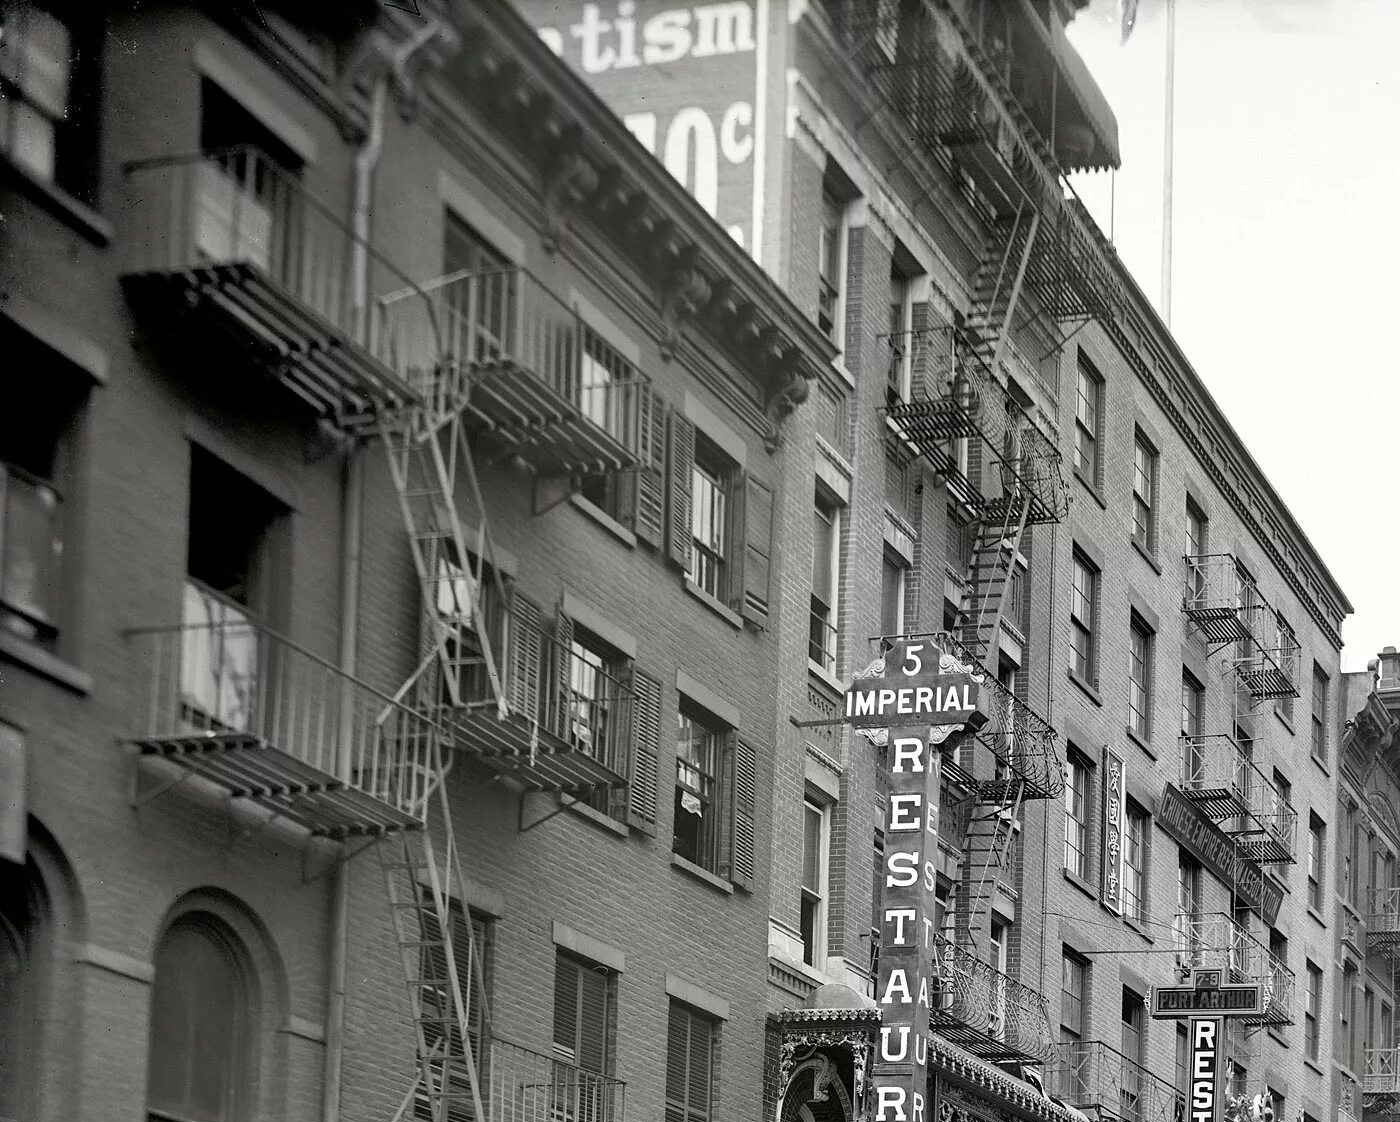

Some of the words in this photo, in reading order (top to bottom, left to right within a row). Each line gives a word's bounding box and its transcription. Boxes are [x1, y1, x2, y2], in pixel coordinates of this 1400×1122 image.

[902, 644, 924, 676] 5
[846, 684, 976, 717] IMPERIAL
[1161, 792, 1196, 839] CHINESE
[1191, 820, 1221, 863] EMPIRE
[1196, 973, 1219, 987] 7-9
[1159, 991, 1196, 1009] PORT
[1200, 990, 1255, 1008] ARTHUR
